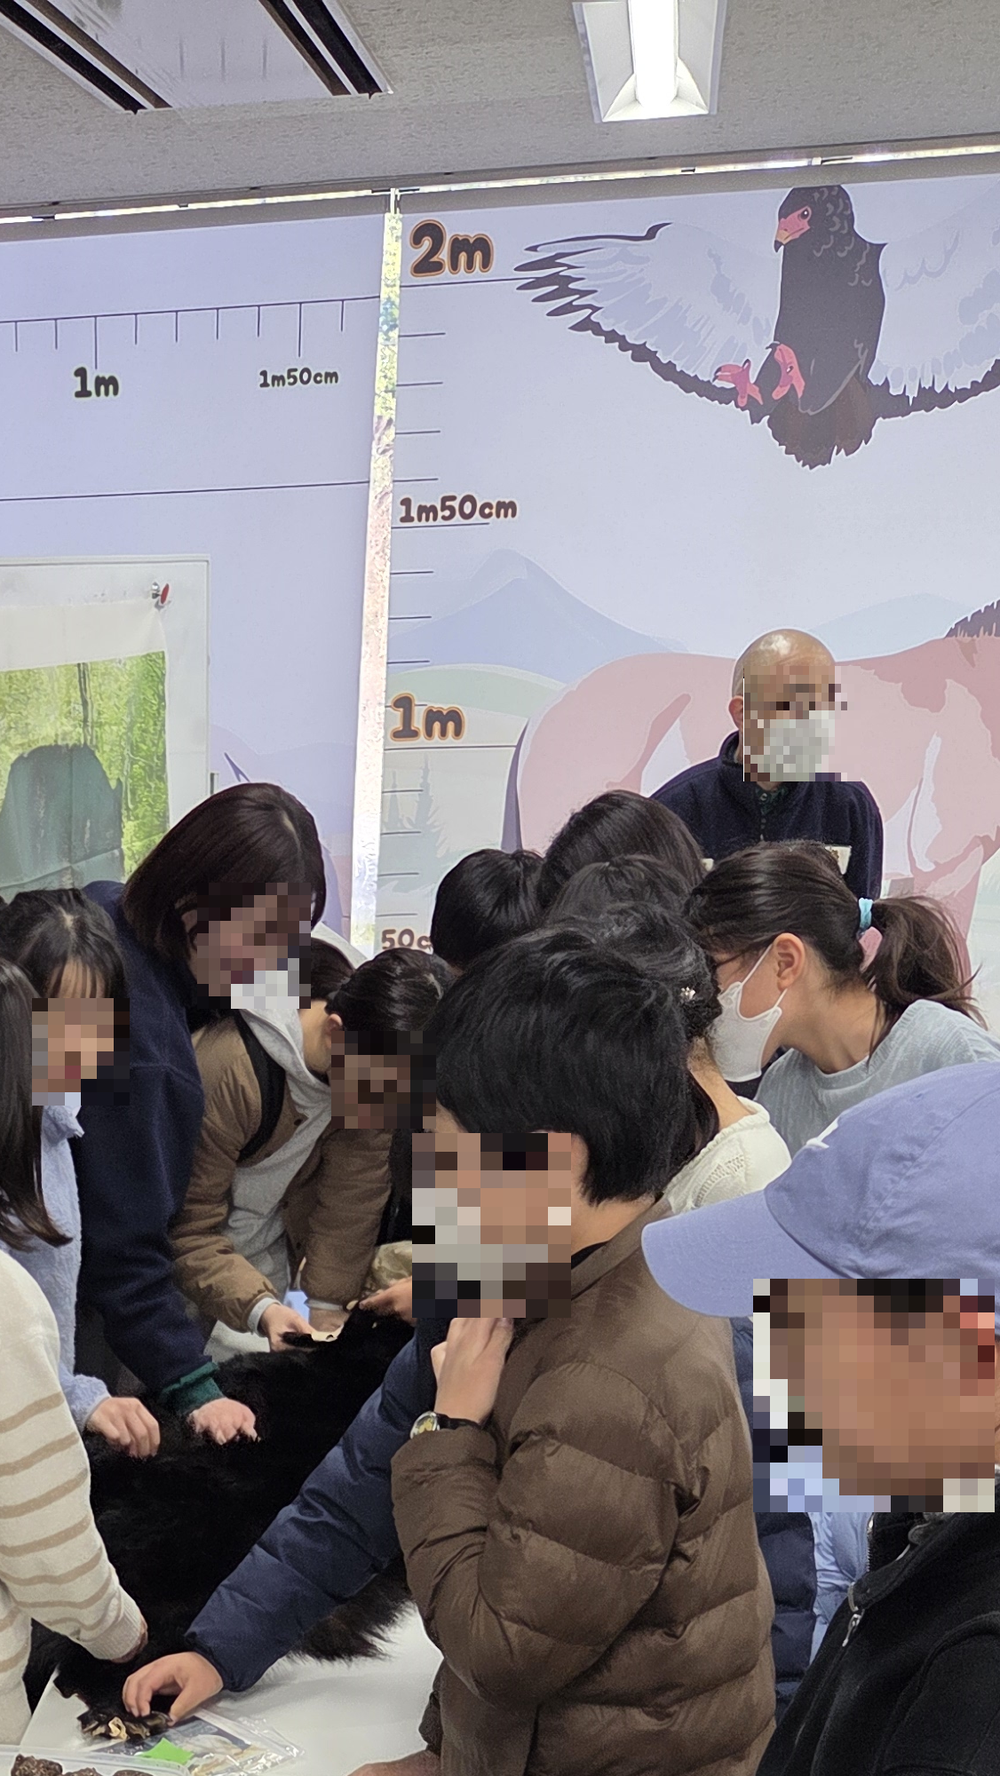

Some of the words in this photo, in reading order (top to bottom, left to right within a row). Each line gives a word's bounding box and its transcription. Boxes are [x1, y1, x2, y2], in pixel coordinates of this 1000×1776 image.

[410, 219, 494, 277] 2m
[73, 366, 119, 398] 1m
[259, 367, 339, 388] 1m50cm
[399, 494, 517, 523] 1m50cm
[390, 692, 464, 742] 1m
[381, 928, 432, 950] 50c
